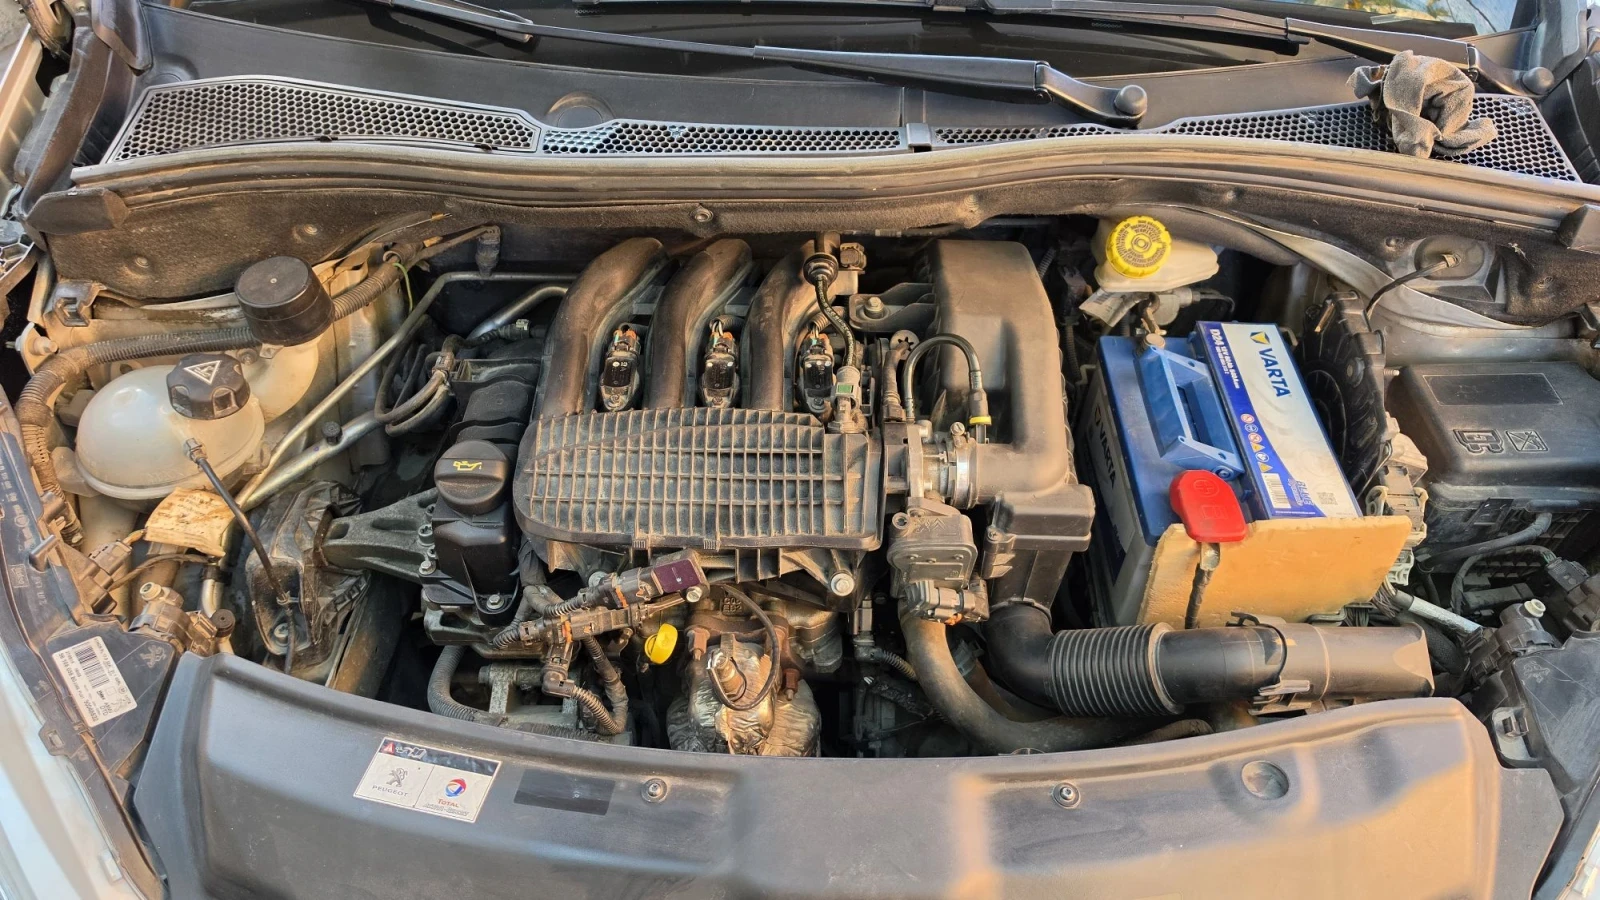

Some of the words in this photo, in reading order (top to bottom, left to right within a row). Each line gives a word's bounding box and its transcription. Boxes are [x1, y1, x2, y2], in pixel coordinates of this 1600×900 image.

[1210, 328, 1224, 346] D24
[1258, 347, 1291, 398] VARTA
[1099, 422, 1117, 490] VARTA
[372, 785, 408, 798] PEUGEOT
[438, 799, 459, 808] TOTAL
